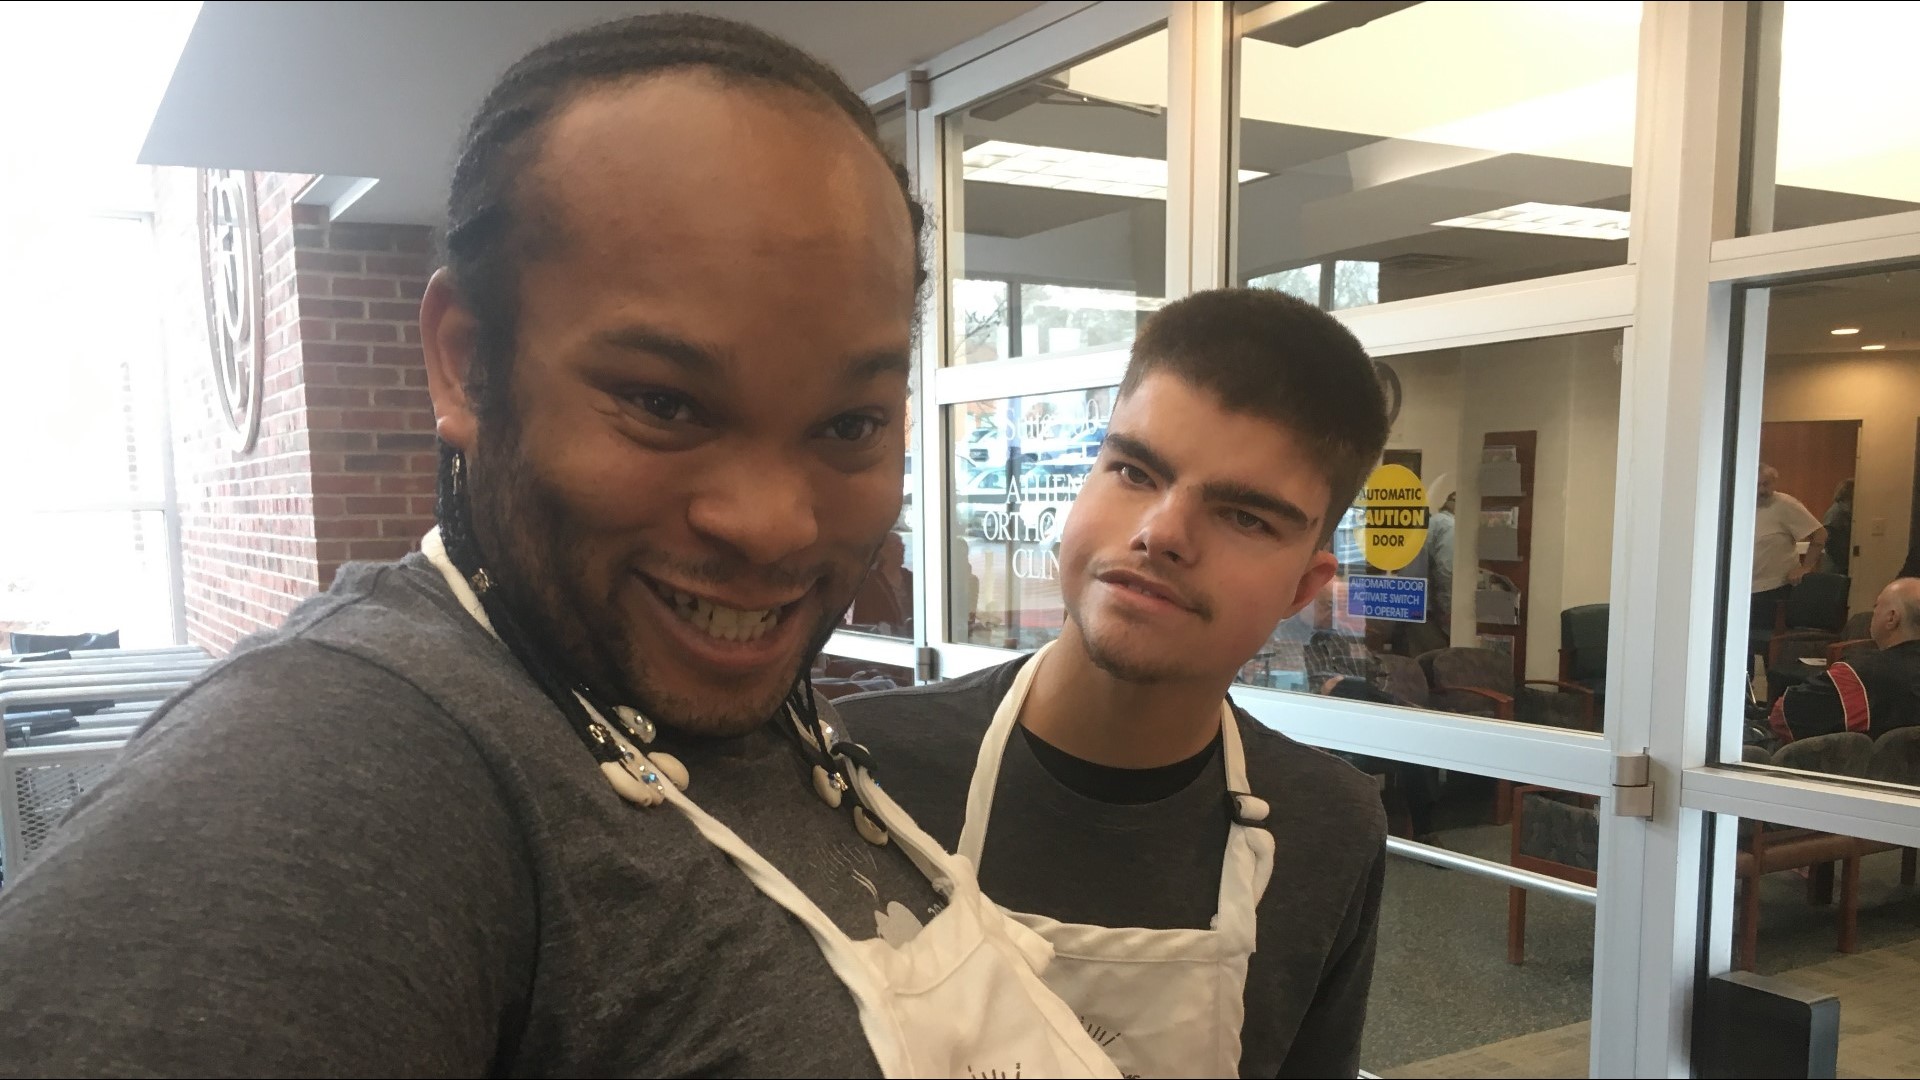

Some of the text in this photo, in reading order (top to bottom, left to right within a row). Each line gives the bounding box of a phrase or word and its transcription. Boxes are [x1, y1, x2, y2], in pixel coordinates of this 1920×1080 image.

[1005, 407, 1055, 441] Suite
[1359, 488, 1422, 501] AUTOMATIC
[1373, 534, 1405, 547] DOOR
[1350, 578, 1424, 592] AUTOMATIC DOOR
[1353, 592, 1420, 605] ACTIVATE SWITCH
[1362, 605, 1374, 615] TO
[1374, 606, 1409, 618] OPERATE
